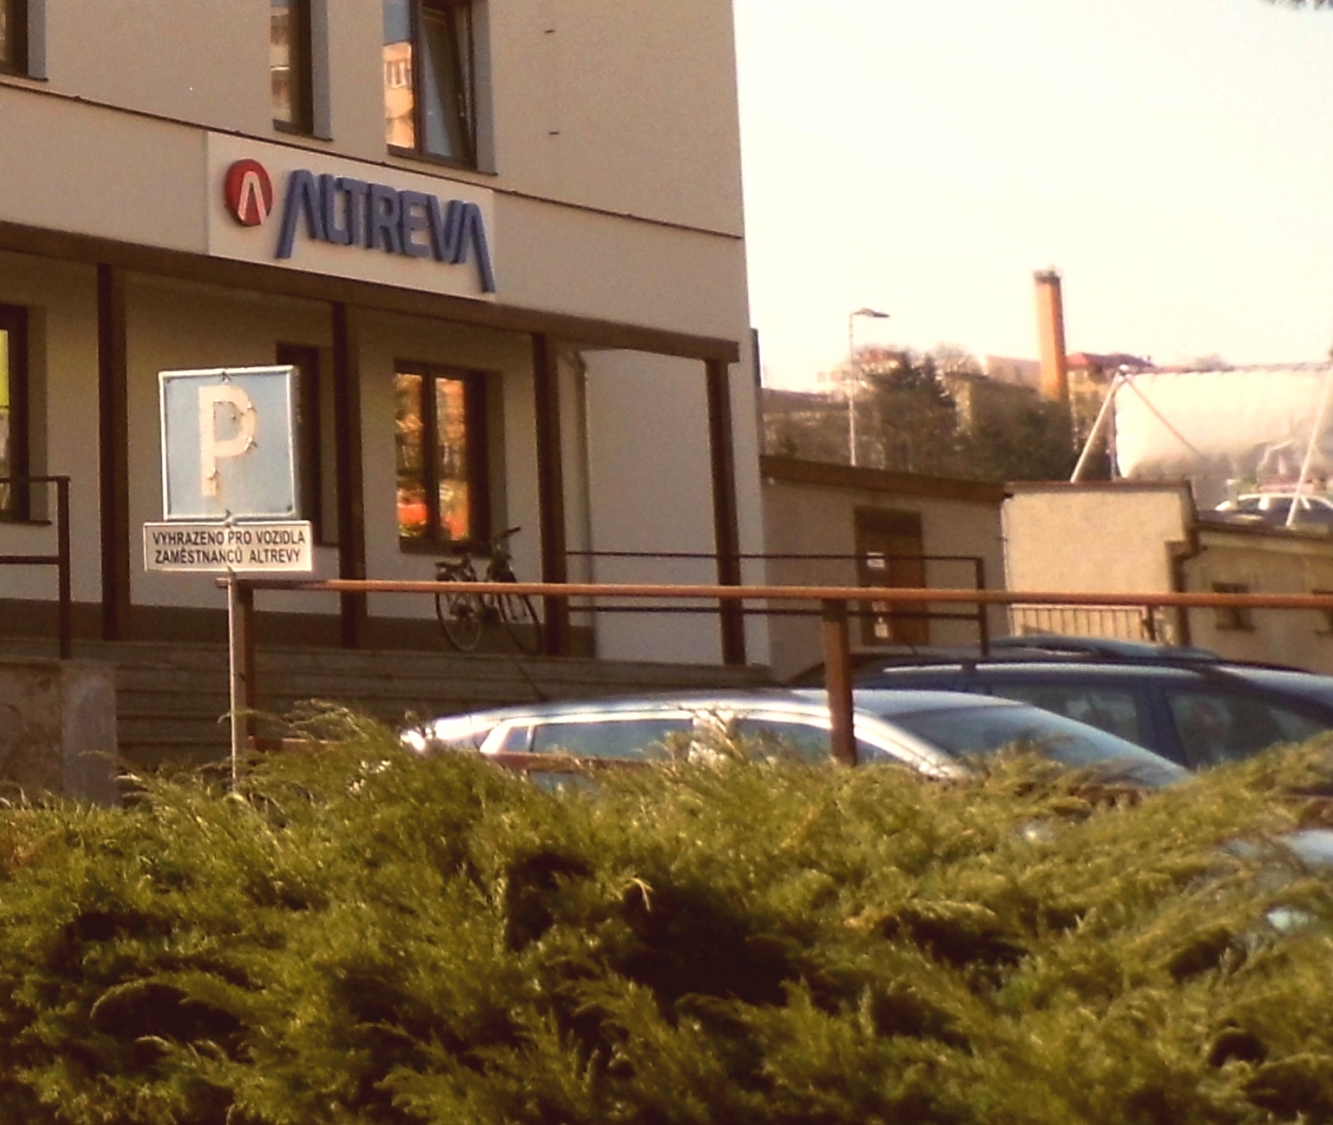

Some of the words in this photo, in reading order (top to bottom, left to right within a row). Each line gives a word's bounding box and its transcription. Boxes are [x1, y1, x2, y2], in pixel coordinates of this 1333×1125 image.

[276, 169, 496, 293] ALTREVA
[198, 385, 256, 496] P
[152, 531, 224, 546] VYHRAZENO
[227, 530, 252, 545] PRO
[255, 529, 306, 545] VOZIDLA
[154, 546, 243, 564] ZAMĚSTNANCŮ
[249, 548, 301, 563] ALTREVY
